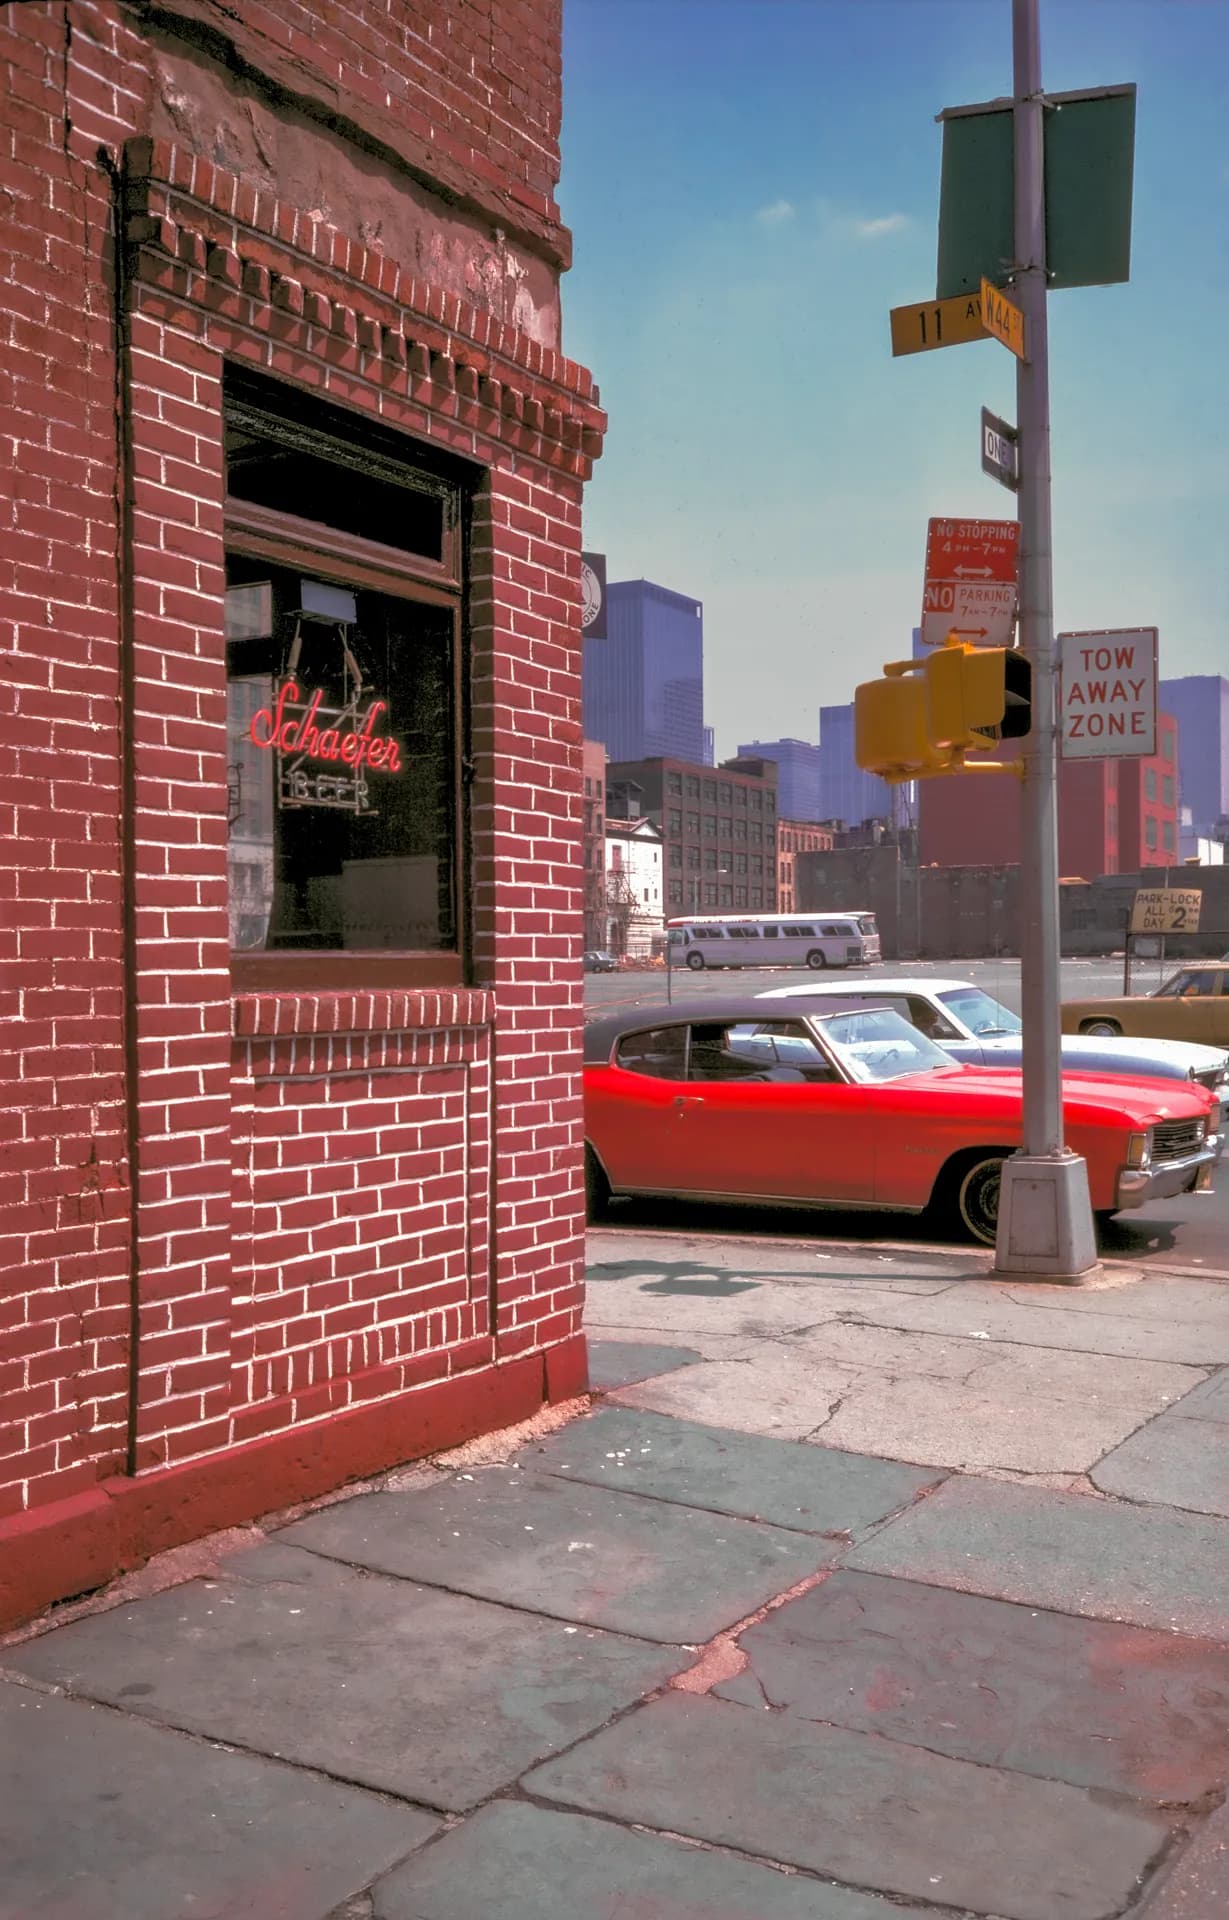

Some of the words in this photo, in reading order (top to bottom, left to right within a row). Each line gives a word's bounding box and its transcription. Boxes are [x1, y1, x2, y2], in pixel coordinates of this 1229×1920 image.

[919, 307, 942, 343] 11
[987, 431, 1007, 466] ONE
[937, 523, 954, 537] NO
[959, 525, 1015, 540] STOPPING
[926, 587, 953, 609] NO
[960, 588, 1010, 602] PARKING
[1079, 646, 1135, 672] TOW
[1067, 679, 1146, 705] AWAY
[250, 681, 402, 773] Schaefer
[1068, 712, 1146, 738] ZONE
[290, 770, 369, 808] BEER
[1143, 918, 1165, 928] DAY
[1144, 906, 1165, 916] ALL
